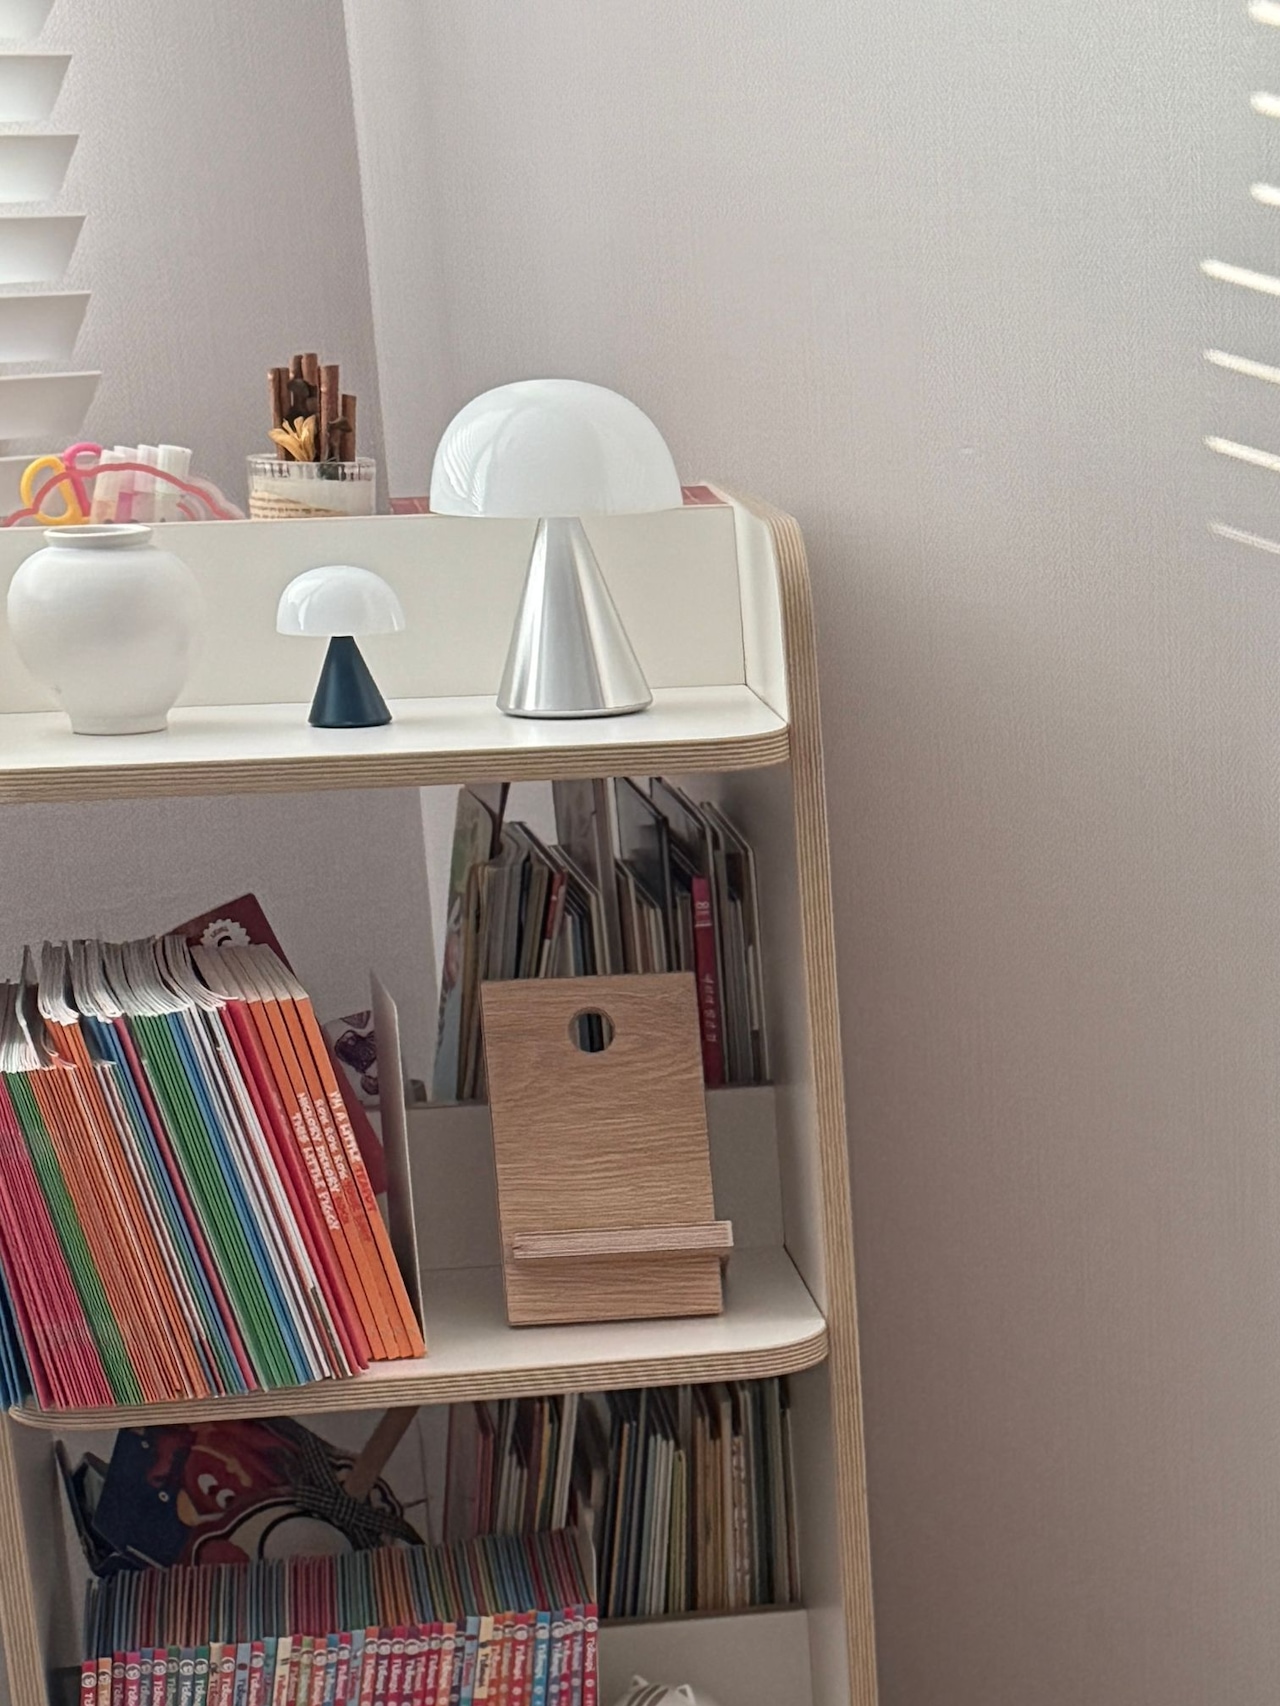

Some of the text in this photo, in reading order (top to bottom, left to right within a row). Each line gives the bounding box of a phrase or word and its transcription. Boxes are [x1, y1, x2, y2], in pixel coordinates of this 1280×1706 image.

[296, 1091, 324, 1142] HICKORY
[339, 1122, 362, 1163] LITTLE
[291, 1111, 340, 1232] THIS LITTLE PIGGY
